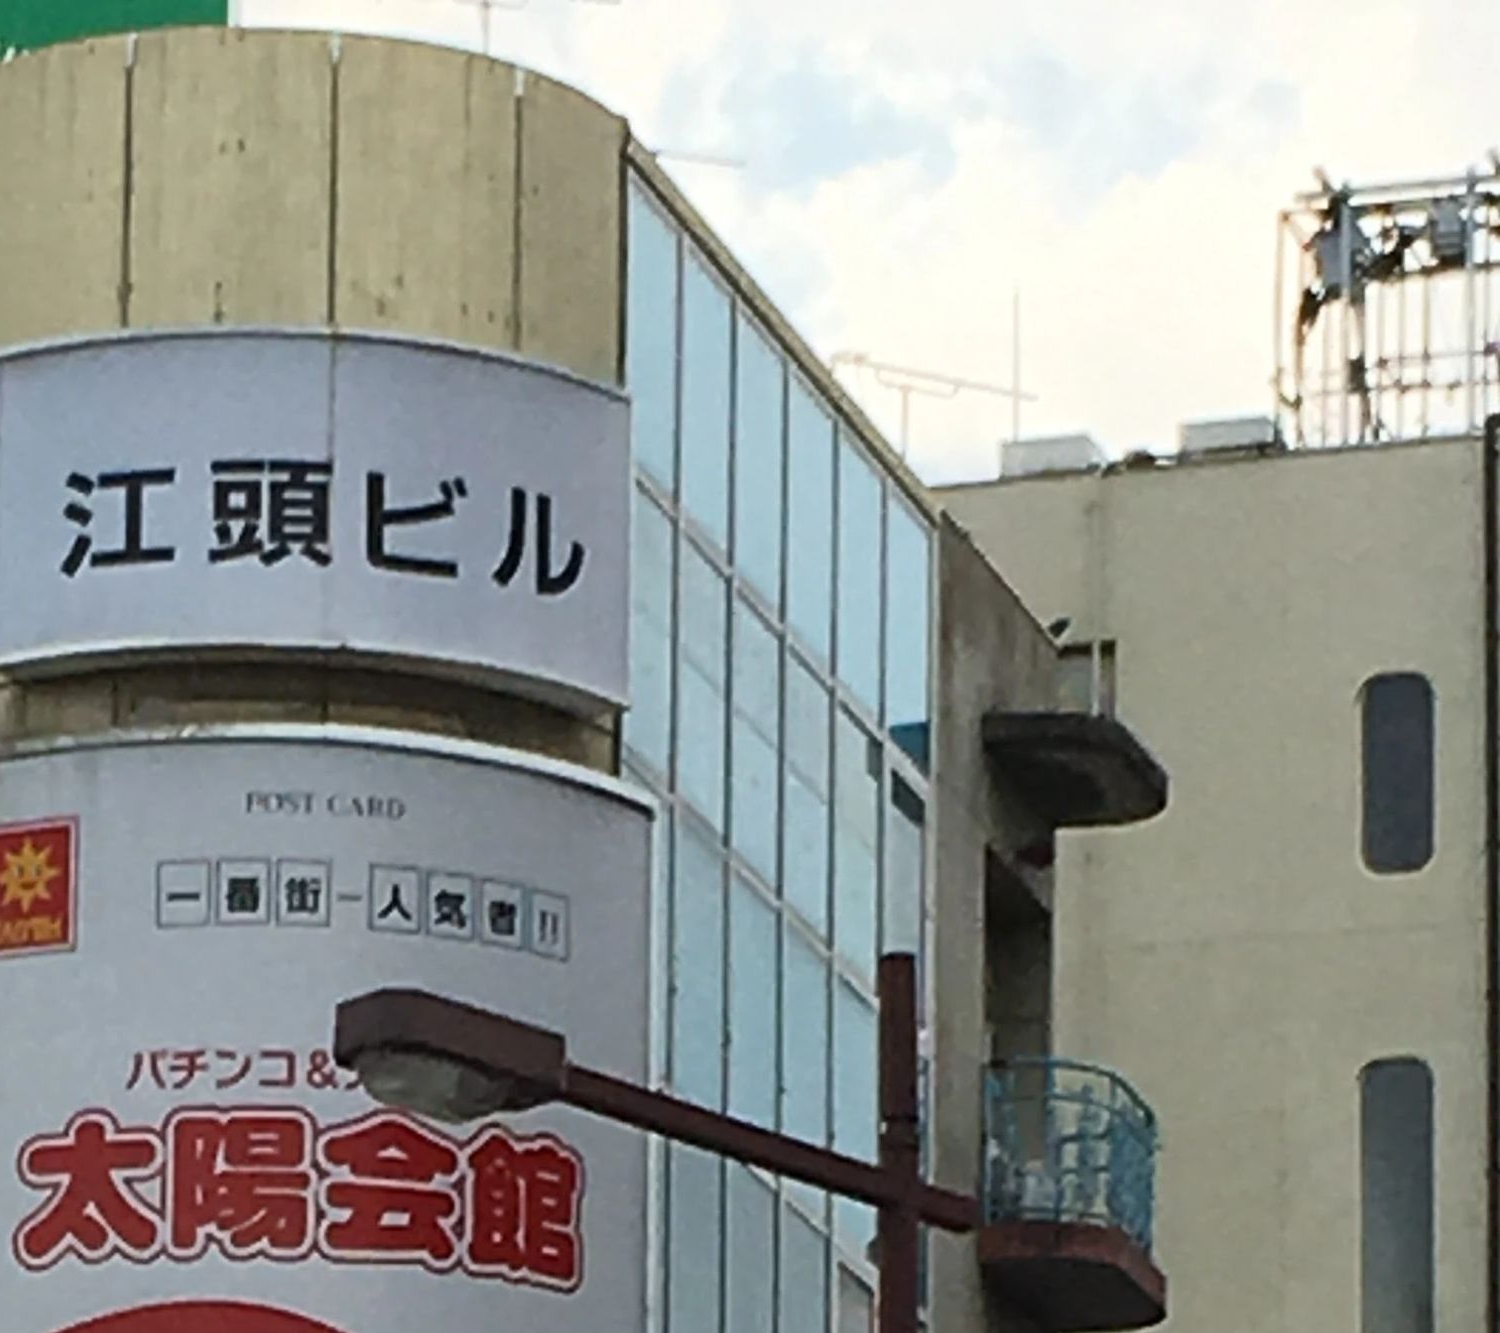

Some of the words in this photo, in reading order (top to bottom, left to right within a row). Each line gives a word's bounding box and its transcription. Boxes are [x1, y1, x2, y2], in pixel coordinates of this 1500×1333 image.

[60, 458, 585, 596] 江頭ビル
[245, 792, 316, 815] POST
[327, 795, 406, 820] CARD
[125, 1048, 362, 1090] パチンコ&
[15, 1107, 583, 1290] 太陽会館
